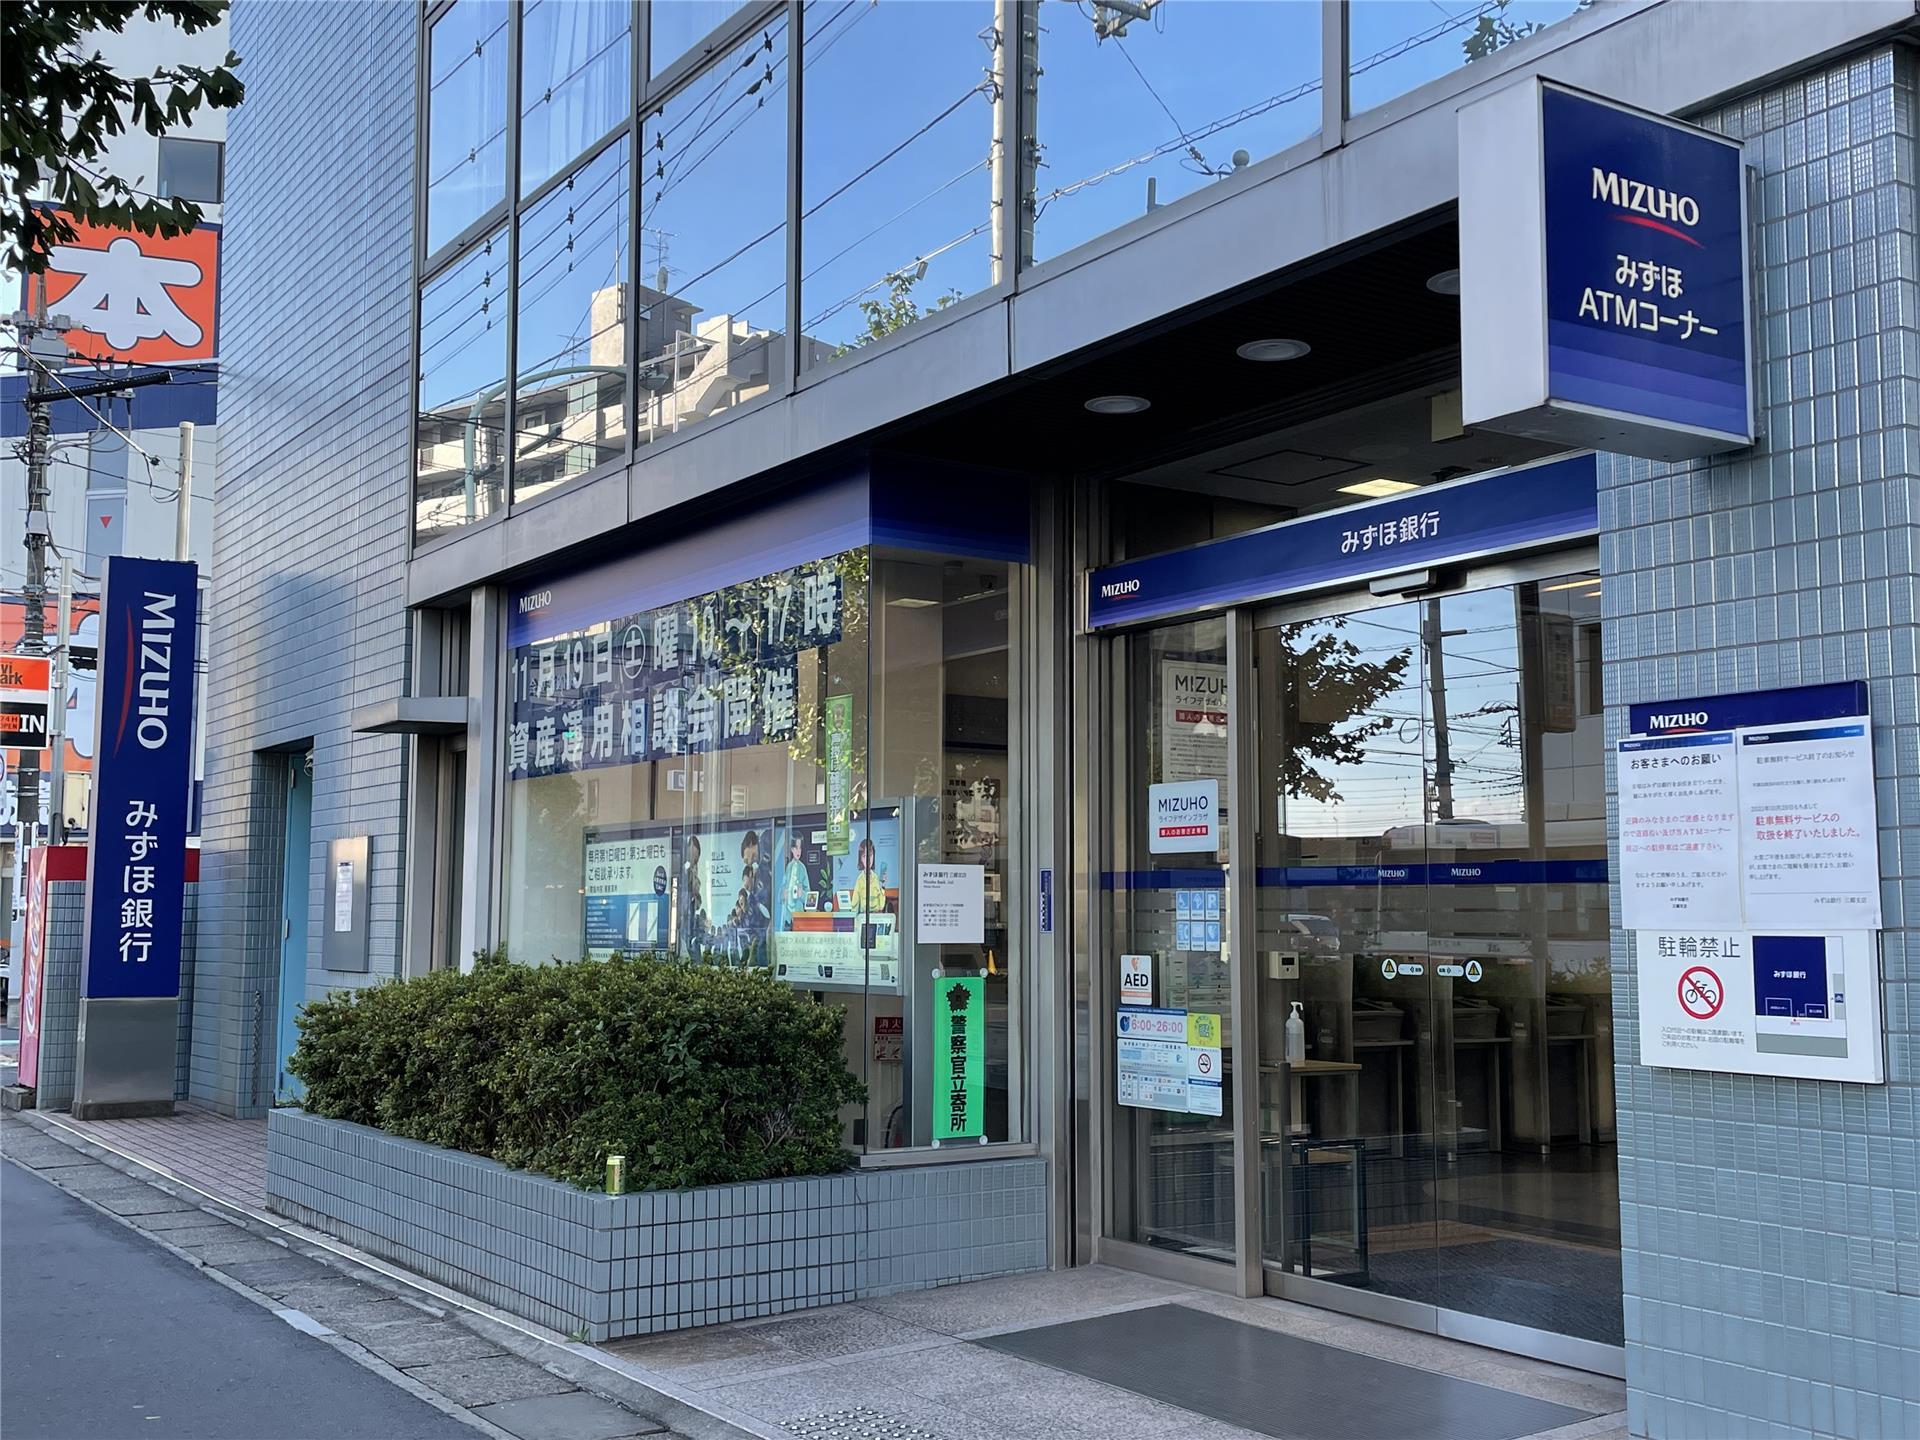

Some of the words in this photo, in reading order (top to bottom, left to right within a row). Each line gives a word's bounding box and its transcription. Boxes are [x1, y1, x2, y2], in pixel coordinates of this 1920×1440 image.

[1592, 167, 1699, 227] MIZUHO
[1615, 254, 1684, 299] みずほ
[47, 236, 204, 350] 本
[1579, 287, 1719, 340] ATMコーナー
[1340, 511, 1441, 554] みずほ銀行
[1101, 579, 1140, 598] MIZUHO
[518, 590, 552, 615] MIZUHO
[136, 591, 178, 752] MIZUHO
[19, 714, 45, 733] IN
[1649, 712, 1709, 730] MIZUHO
[1630, 753, 1721, 770] お客さまへのお願い
[1159, 795, 1209, 813] MIZUHO
[1755, 813, 1840, 826] 駐車無料サービスの
[1756, 827, 1860, 841] 取扱を終了いたしました。
[118, 800, 160, 964] みずほ銀行
[1378, 869, 1405, 878] MIZUHO
[1451, 868, 1481, 877] MIZUHO
[1658, 936, 1741, 959] 駐輪禁止
[1124, 973, 1149, 987] AED
[950, 1015, 967, 1133] 警察官立寄所
